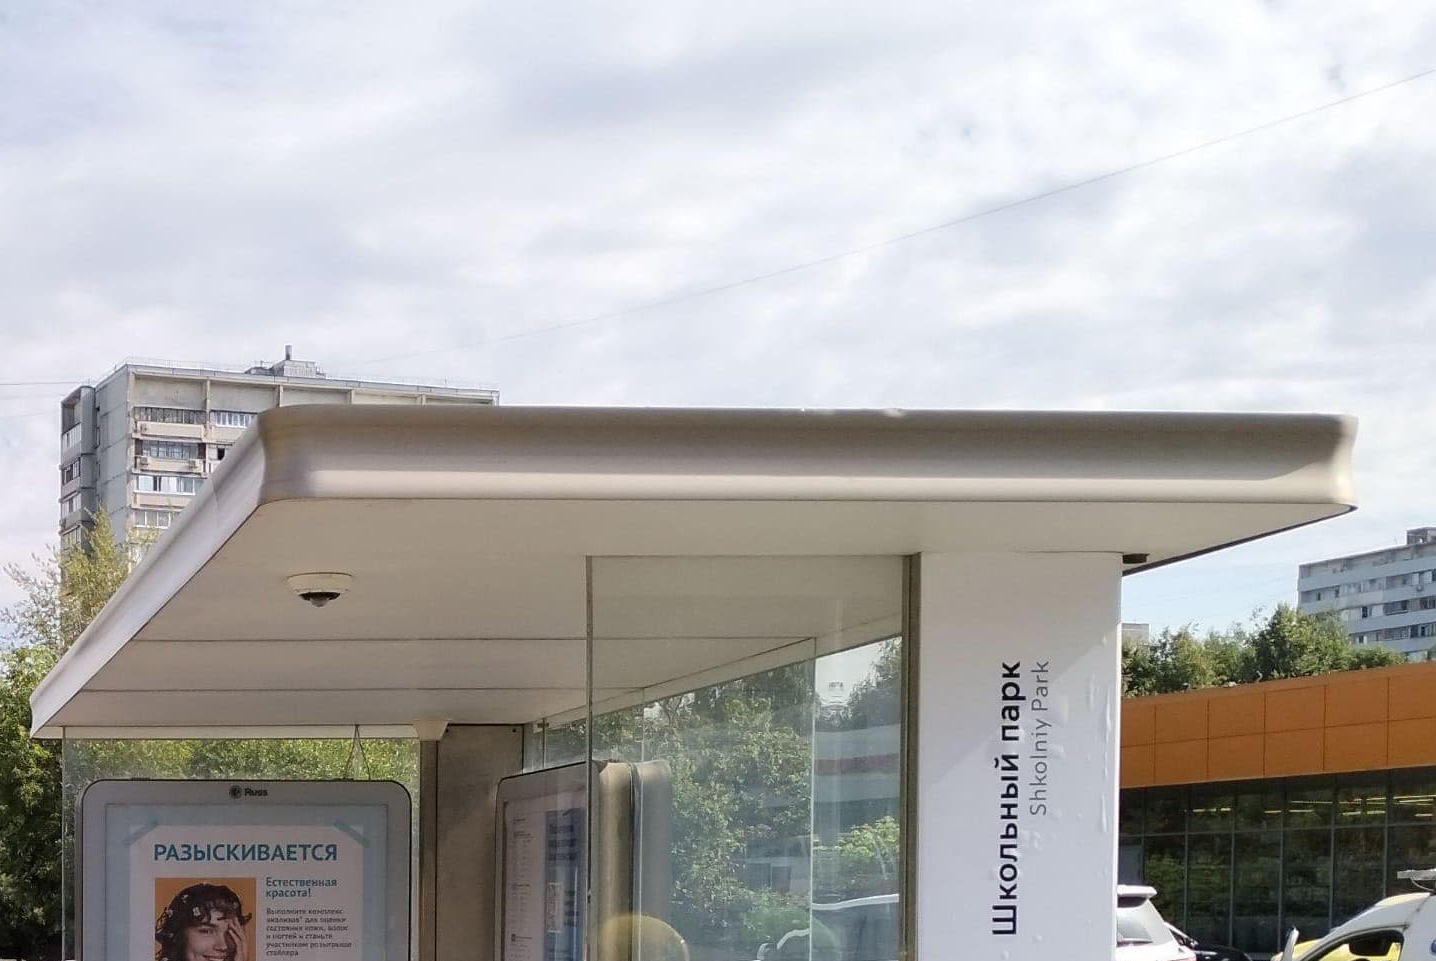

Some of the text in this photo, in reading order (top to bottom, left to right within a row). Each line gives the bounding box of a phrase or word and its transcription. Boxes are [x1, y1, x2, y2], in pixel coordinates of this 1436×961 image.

[1029, 660, 1052, 816] Shkolniy Park
[992, 661, 1026, 935] Школьный парк
[154, 844, 338, 861] РАЗЫСКИВАЕТСЯ
[266, 877, 338, 887] Естественная
[266, 888, 311, 899] красота!
